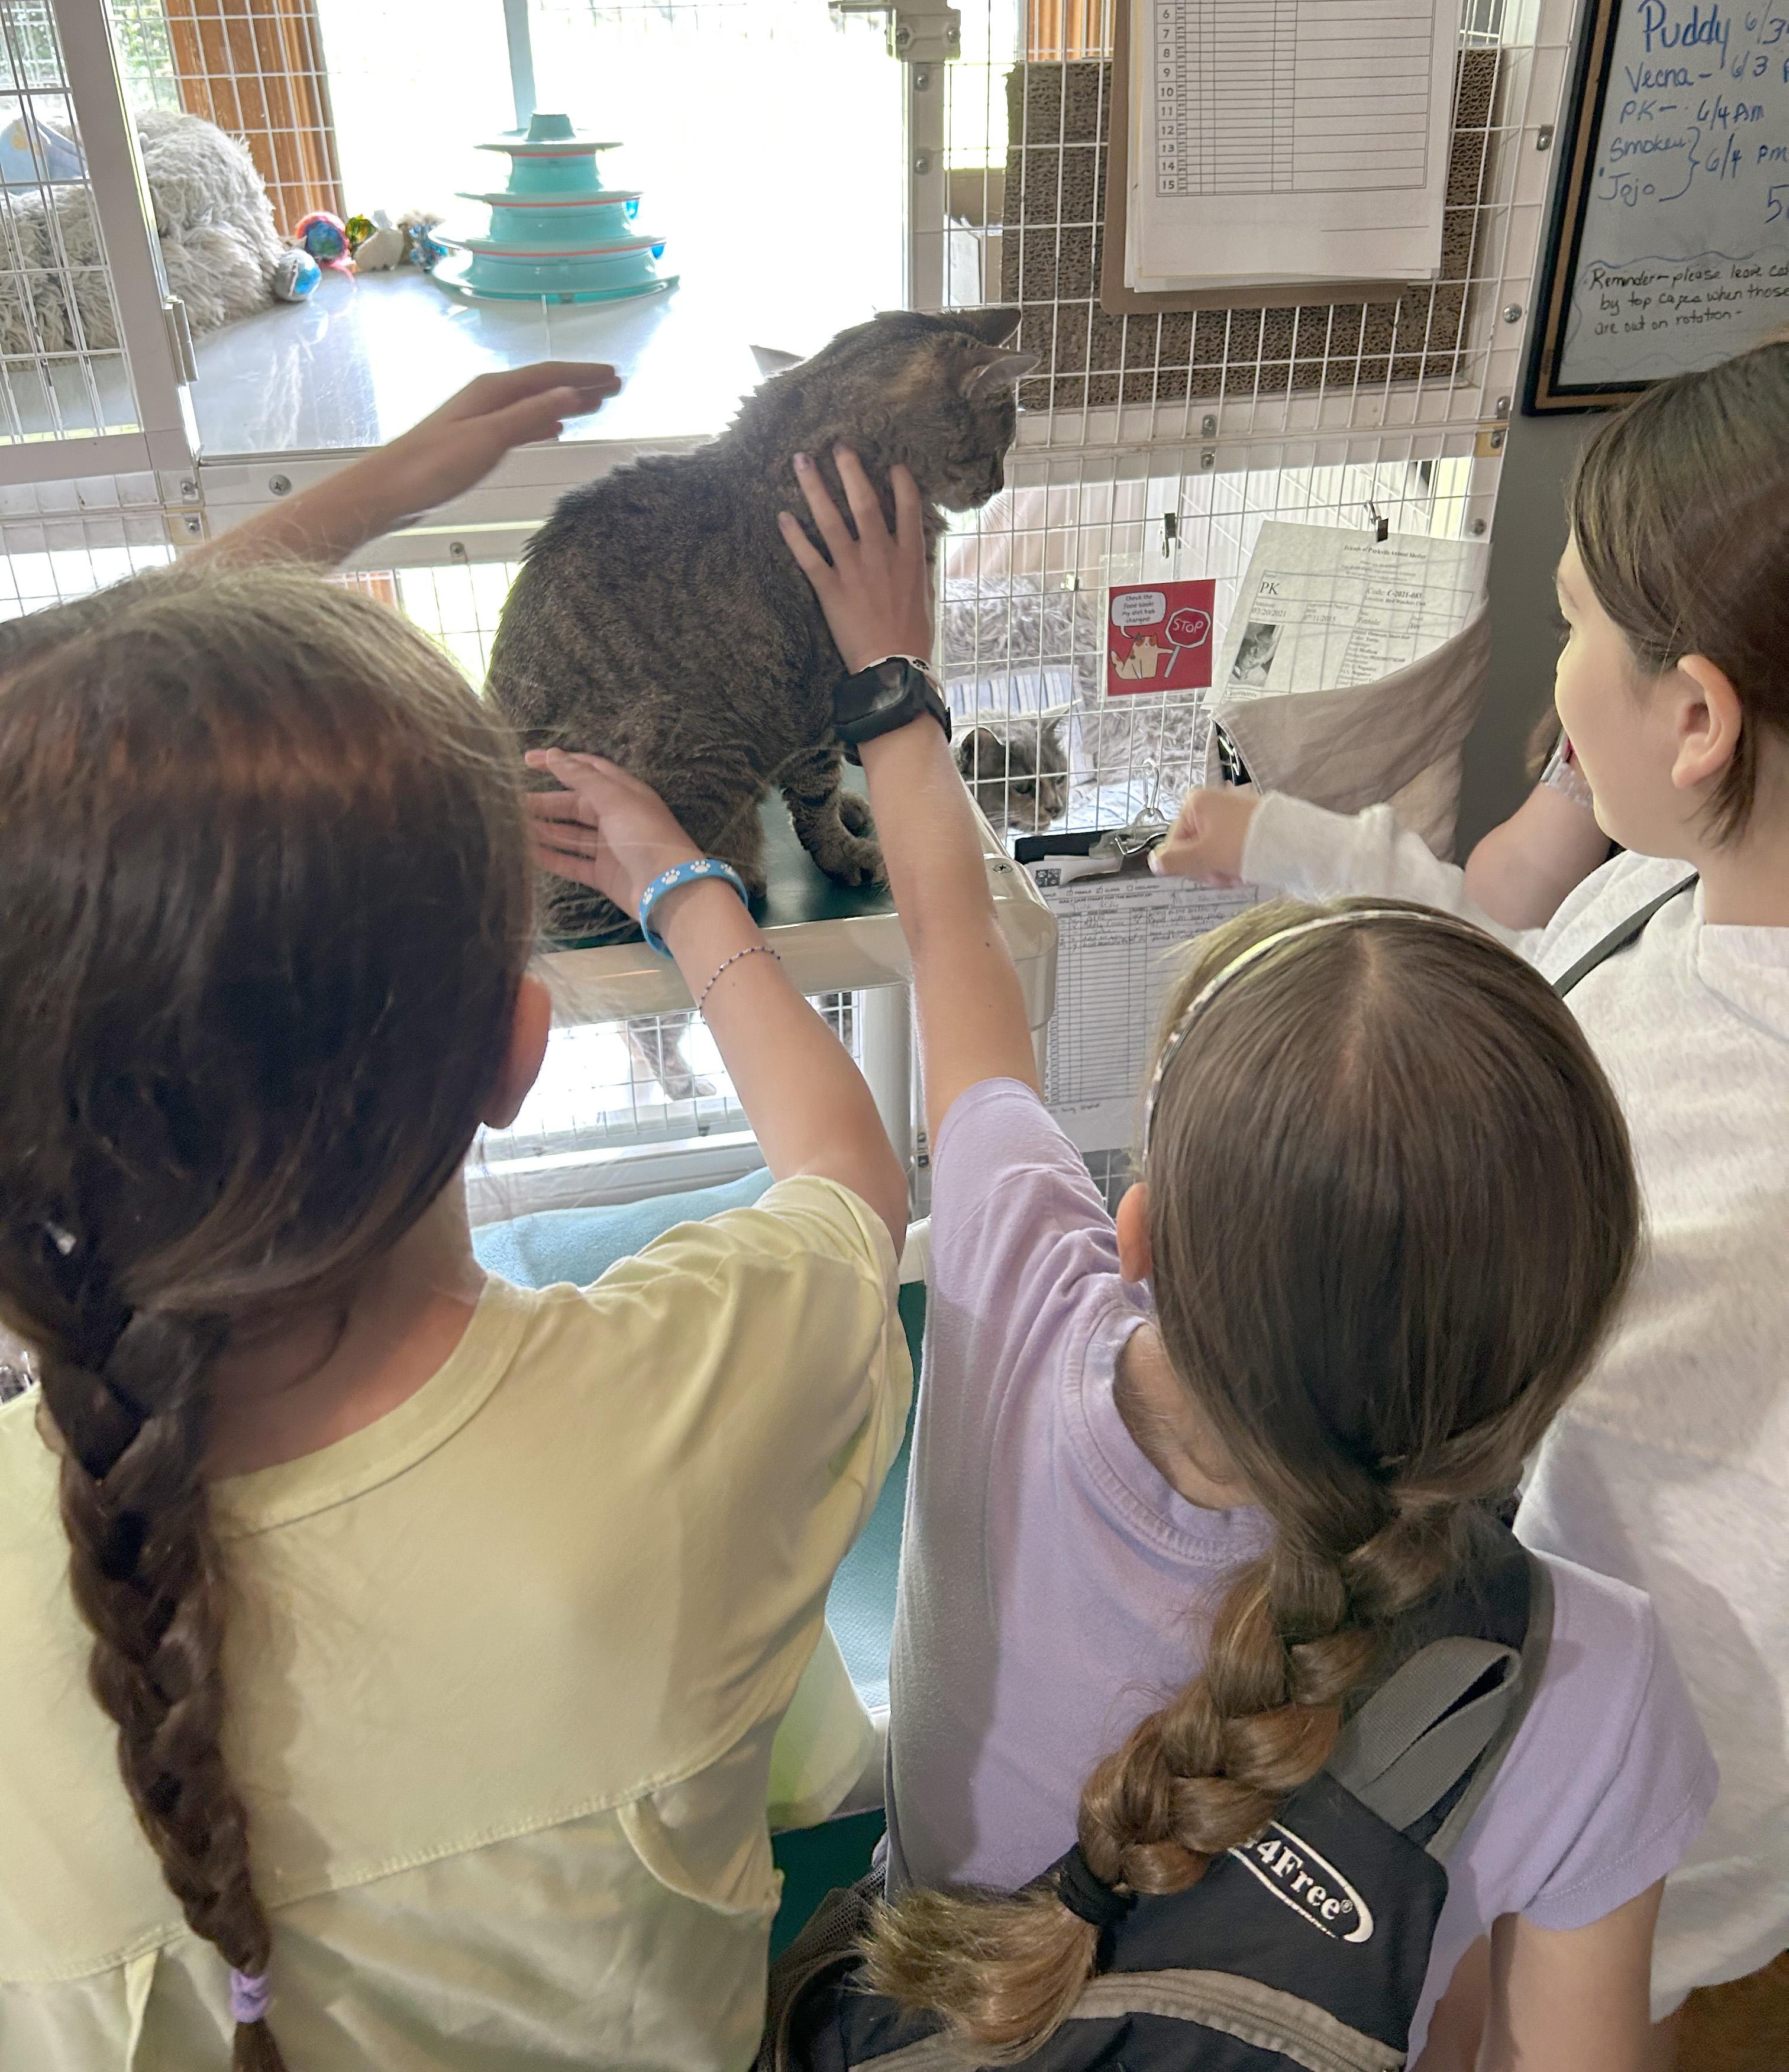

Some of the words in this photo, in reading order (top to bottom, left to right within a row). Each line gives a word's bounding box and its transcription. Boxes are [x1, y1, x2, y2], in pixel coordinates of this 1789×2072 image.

[1162, 9, 1170, 19] 6
[1163, 29, 1170, 38] 7
[1638, 0, 1731, 70] Puddy
[1163, 48, 1170, 57] 8
[1163, 68, 1170, 77] 9
[1161, 88, 1174, 97] 10
[1162, 106, 1173, 116] 11
[1162, 126, 1174, 135] 12
[1162, 144, 1174, 153] 13
[1162, 162, 1175, 171] 14
[1162, 180, 1174, 189] 15
[1598, 172, 1656, 207] Jojo
[1600, 293, 1620, 316] by
[1627, 290, 1652, 311] top
[1707, 286, 1743, 302] when
[1594, 322, 1619, 335] are
[1624, 314, 1646, 334] out
[1651, 320, 1668, 331] on
[1260, 581, 1281, 596] PK
[1171, 618, 1204, 633] STOP
[1358, 616, 1381, 626] Female
